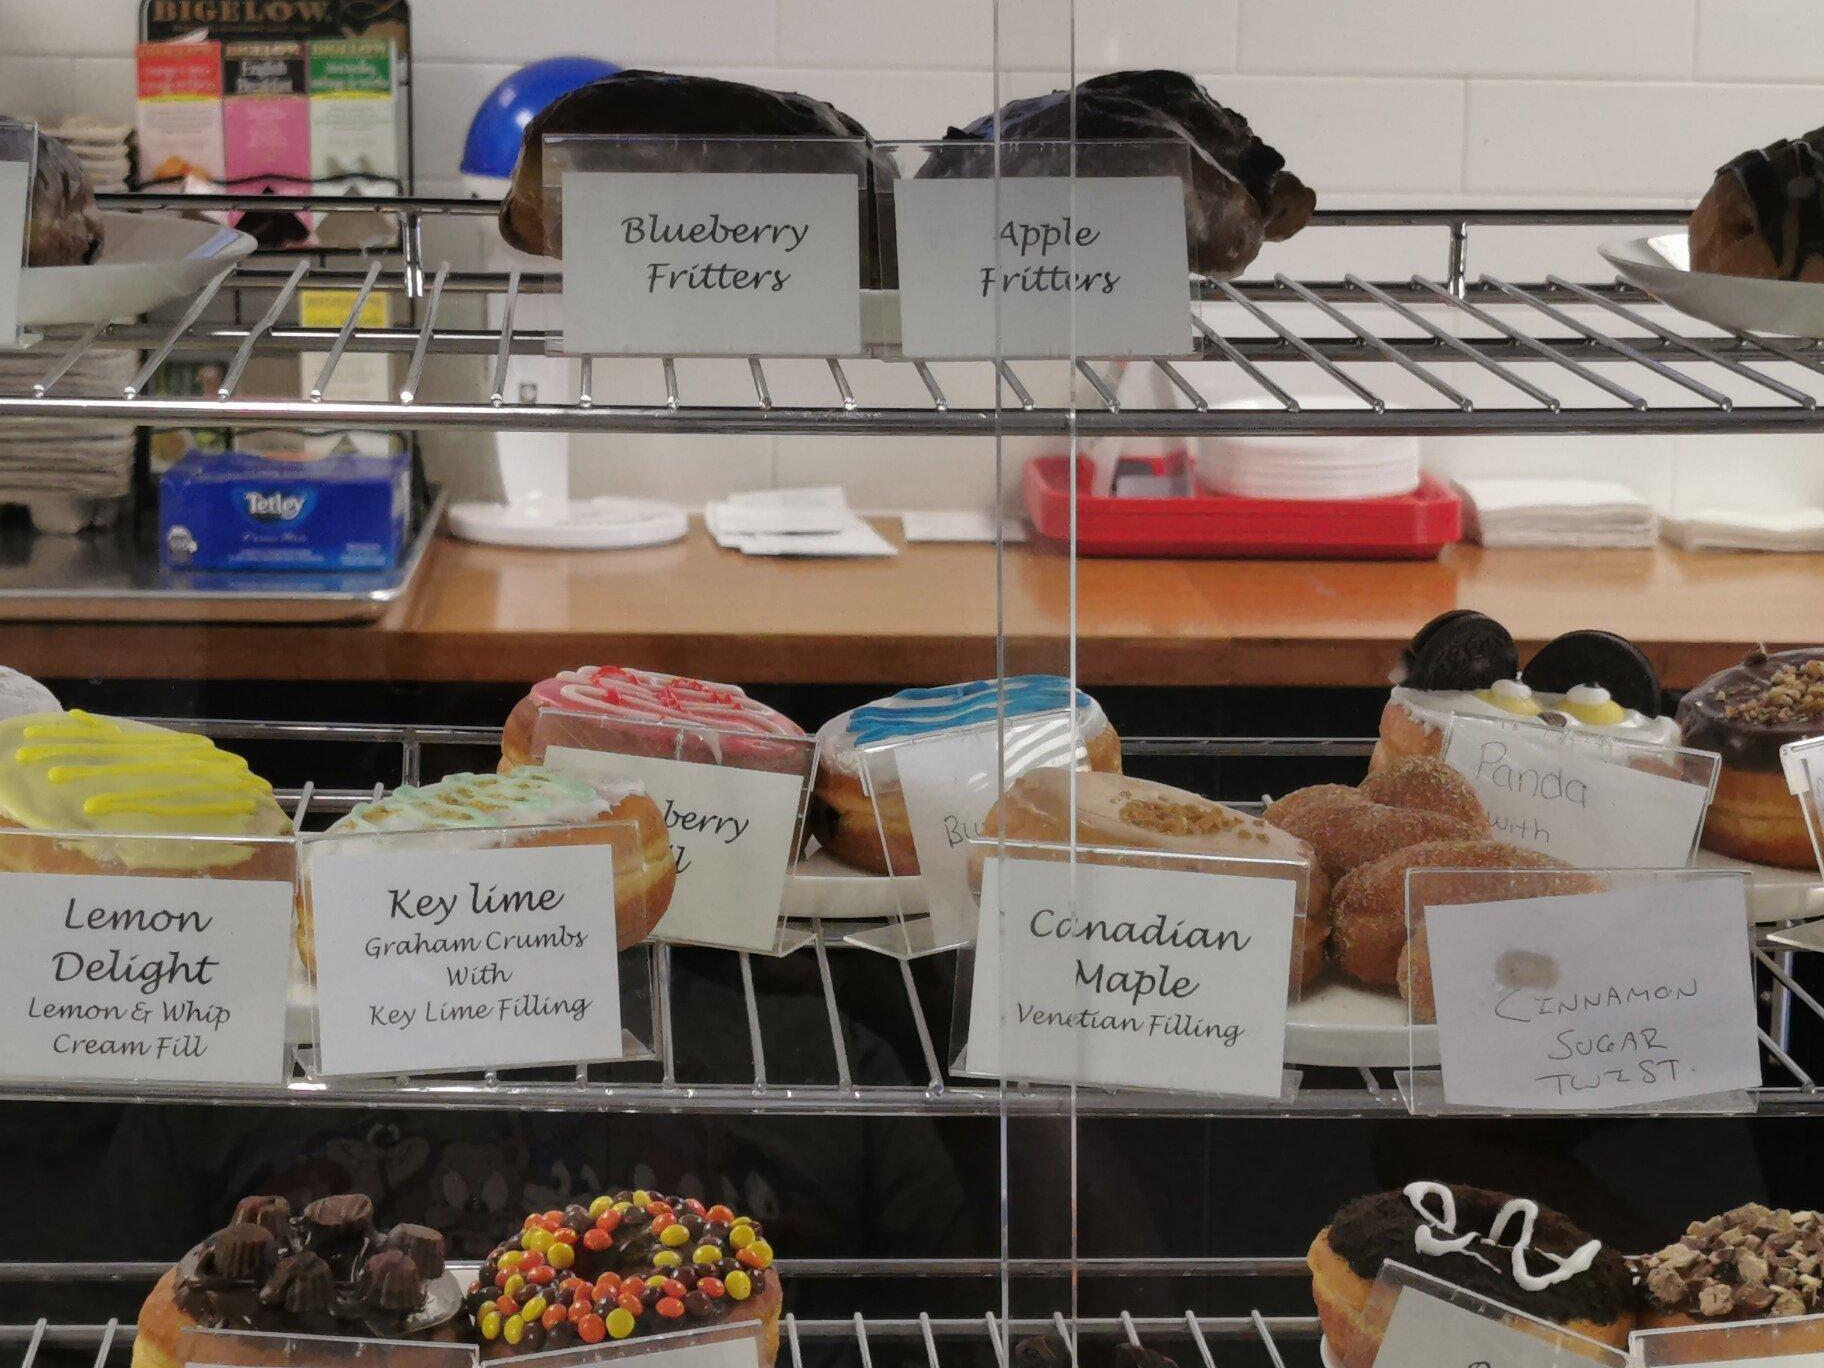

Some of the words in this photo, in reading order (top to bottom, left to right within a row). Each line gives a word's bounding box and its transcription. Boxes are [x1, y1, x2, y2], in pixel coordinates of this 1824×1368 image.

[622, 213, 809, 252] Blueberry
[999, 216, 1101, 263] Apple
[647, 261, 792, 292] Fritters
[980, 264, 1121, 298] Fritters
[243, 491, 308, 520] Tetley
[1476, 741, 1587, 808] Panda
[64, 897, 213, 932] Lemon
[388, 888, 457, 925] Key
[469, 882, 565, 914] lime
[365, 933, 482, 959] Graham
[486, 925, 589, 951] Crumbs
[1030, 909, 1251, 951] Canadian
[52, 949, 220, 994] Delight
[446, 963, 513, 986] With
[1075, 959, 1200, 1005] Maple
[28, 997, 126, 1020] Lemon
[162, 1000, 231, 1031] Whip
[369, 1005, 416, 1030] Key
[426, 1001, 493, 1023] Lime
[498, 994, 593, 1021] Filling
[1017, 1002, 1145, 1032] Venetian
[1148, 1013, 1245, 1047] Filling
[53, 1033, 151, 1056] Cream
[156, 1034, 208, 1059] Fill
[1548, 1027, 1670, 1061] SUGAR
